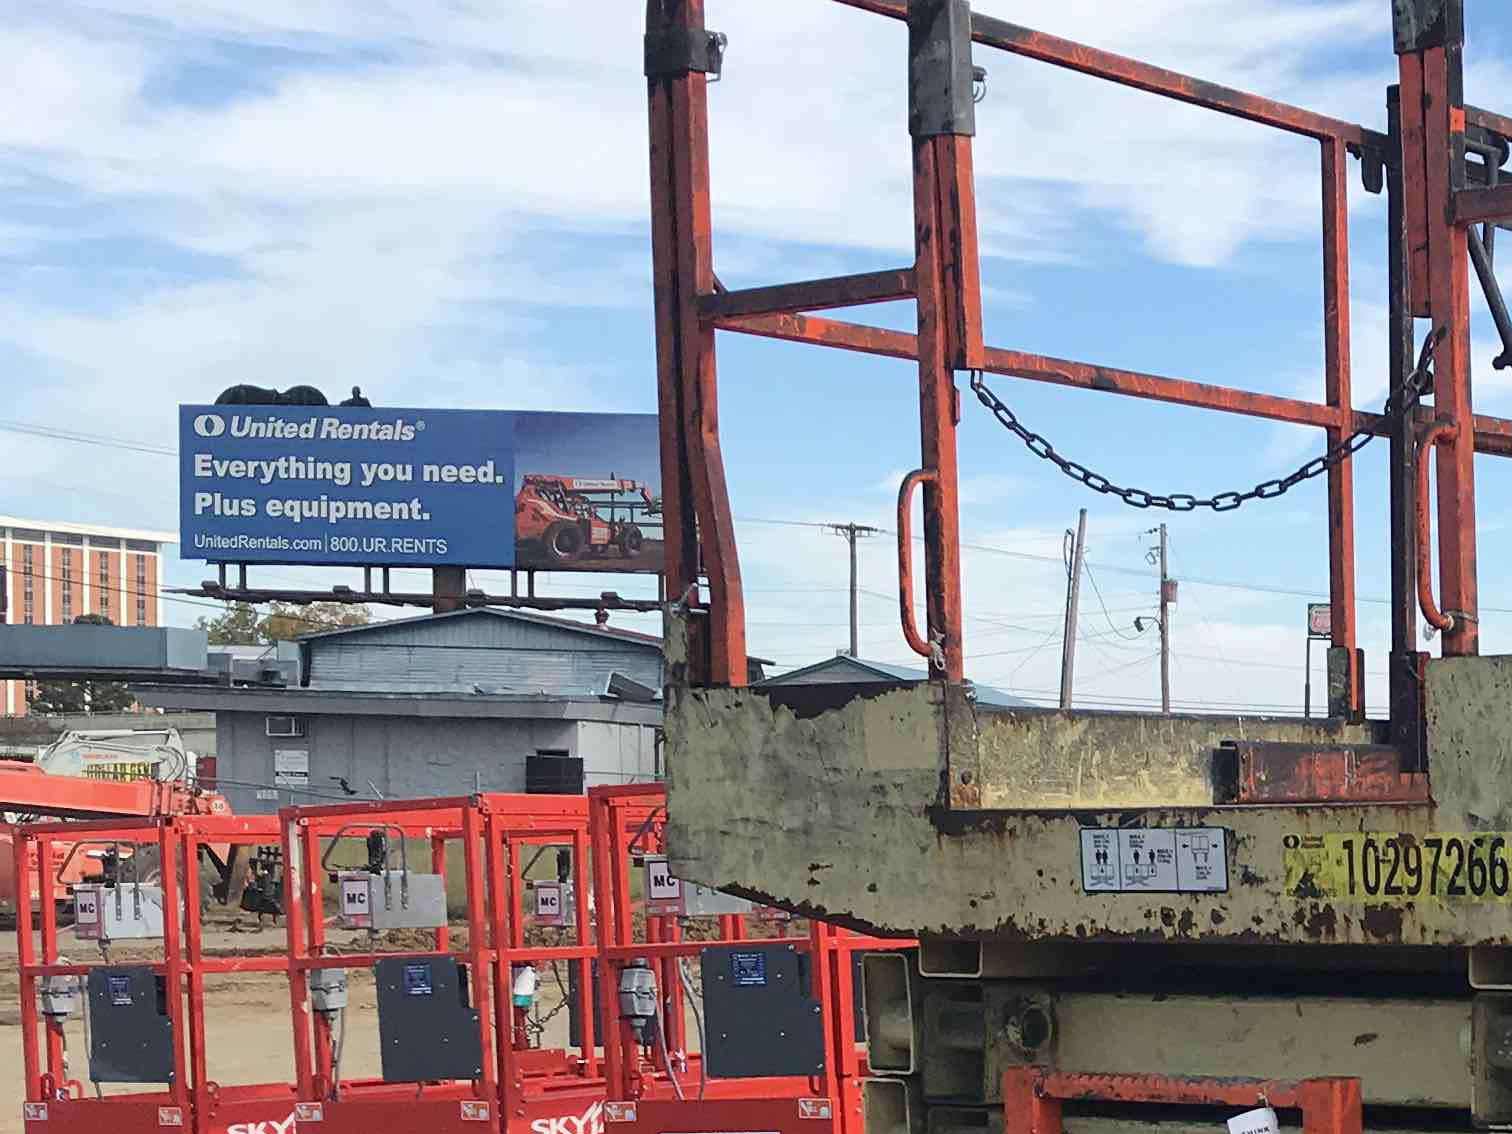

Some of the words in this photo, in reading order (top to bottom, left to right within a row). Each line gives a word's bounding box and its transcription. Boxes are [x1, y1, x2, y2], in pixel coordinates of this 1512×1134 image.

[230, 415, 316, 440] United
[319, 418, 416, 442] Rentals
[194, 454, 352, 486] Everything
[361, 461, 417, 488] you
[422, 459, 504, 484] need.
[194, 492, 257, 517] Plus
[265, 494, 431, 524] equipment.
[194, 534, 322, 552] UnitedRentals.com
[330, 536, 448, 555] 800.UR.RENTS
[1342, 837, 1510, 898] 10297266
[653, 875, 676, 887] MC
[78, 902, 96, 913] MC
[346, 892, 367, 905] MC
[540, 896, 557, 906] MC
